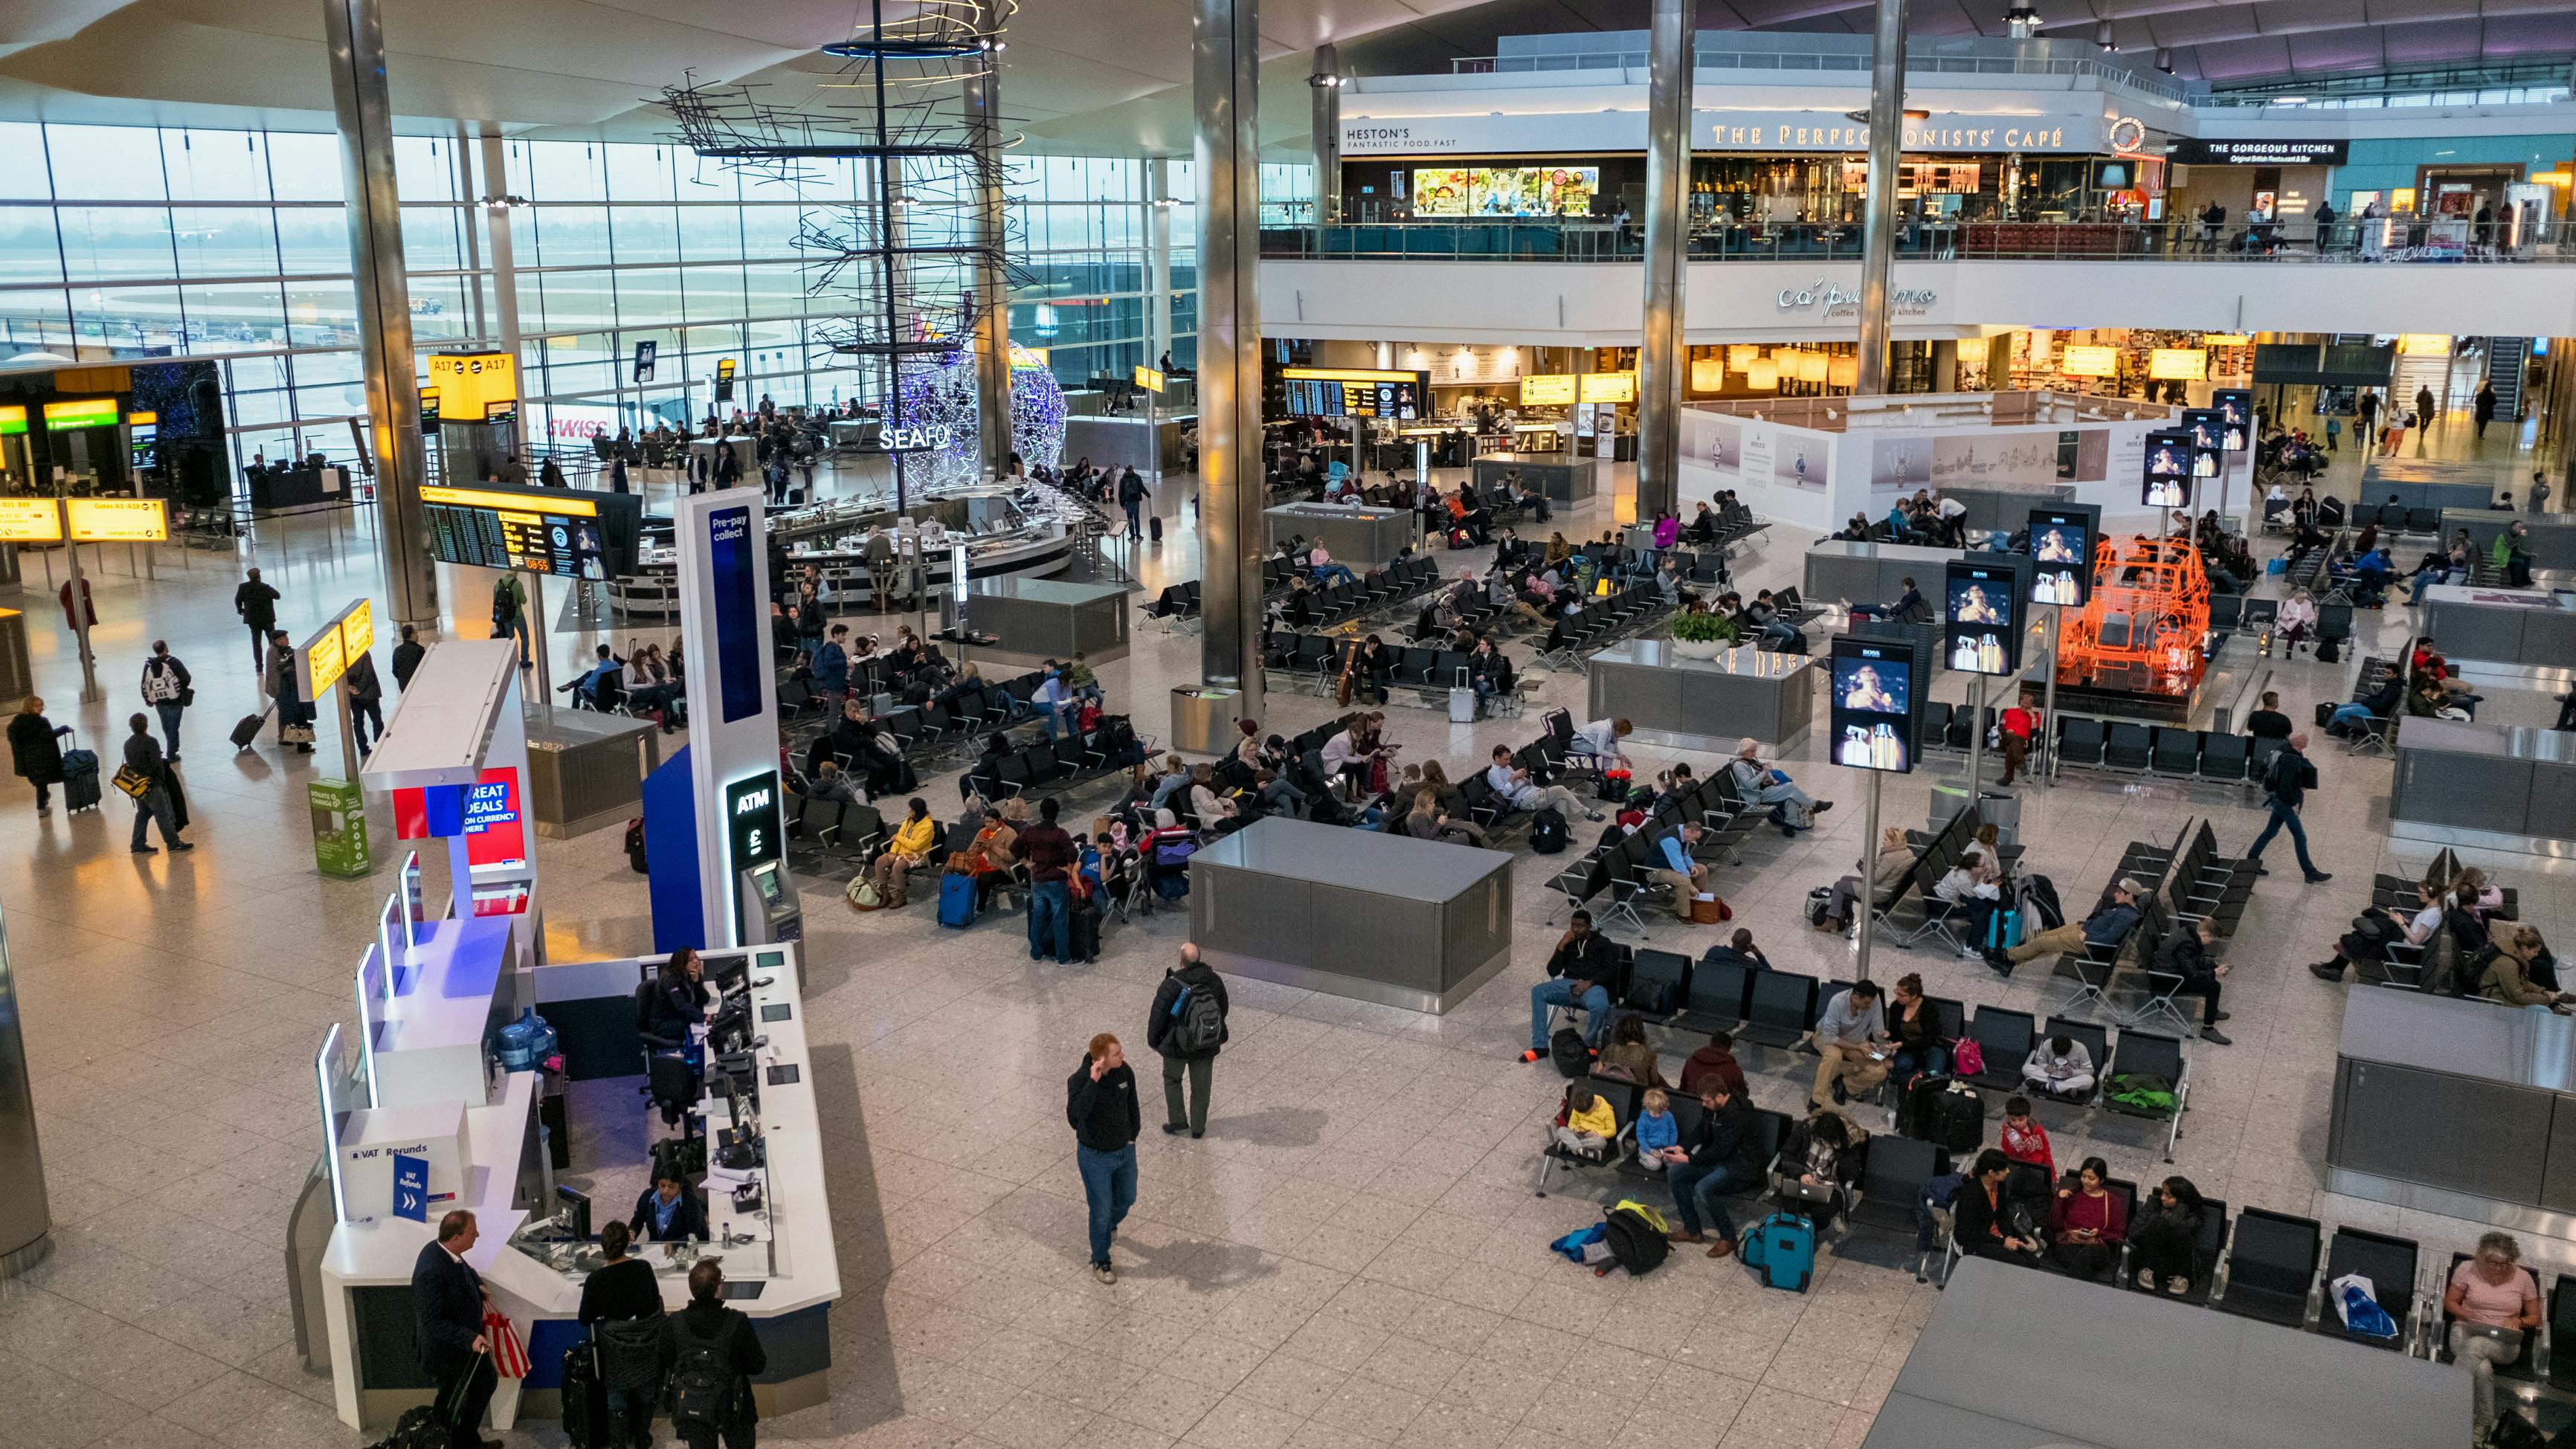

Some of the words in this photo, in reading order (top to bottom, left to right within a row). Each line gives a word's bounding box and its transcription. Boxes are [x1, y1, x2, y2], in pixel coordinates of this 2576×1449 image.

[1347, 129, 1409, 139] HESTON'S
[1713, 125, 1762, 144] THE
[1779, 125, 1995, 146] PERFECONISTS'
[2005, 127, 2064, 147] CAFÉ
[2209, 144, 2229, 152] THE
[2232, 144, 2288, 152] GORGEOUS
[2290, 144, 2335, 152] KITCHEN
[434, 361, 451, 371] A17
[486, 359, 506, 370] A17
[712, 516, 747, 529] Pre-pay
[714, 527, 744, 541] collect
[527, 559, 549, 571] 08:55
[472, 785, 504, 798] REAT
[736, 789, 770, 815] ATM
[477, 813, 515, 823] CURRENCY
[465, 824, 484, 833] HERE
[362, 1149, 379, 1158] VAT
[386, 1144, 428, 1156] Refunds
[399, 1178, 422, 1190] Refunds
